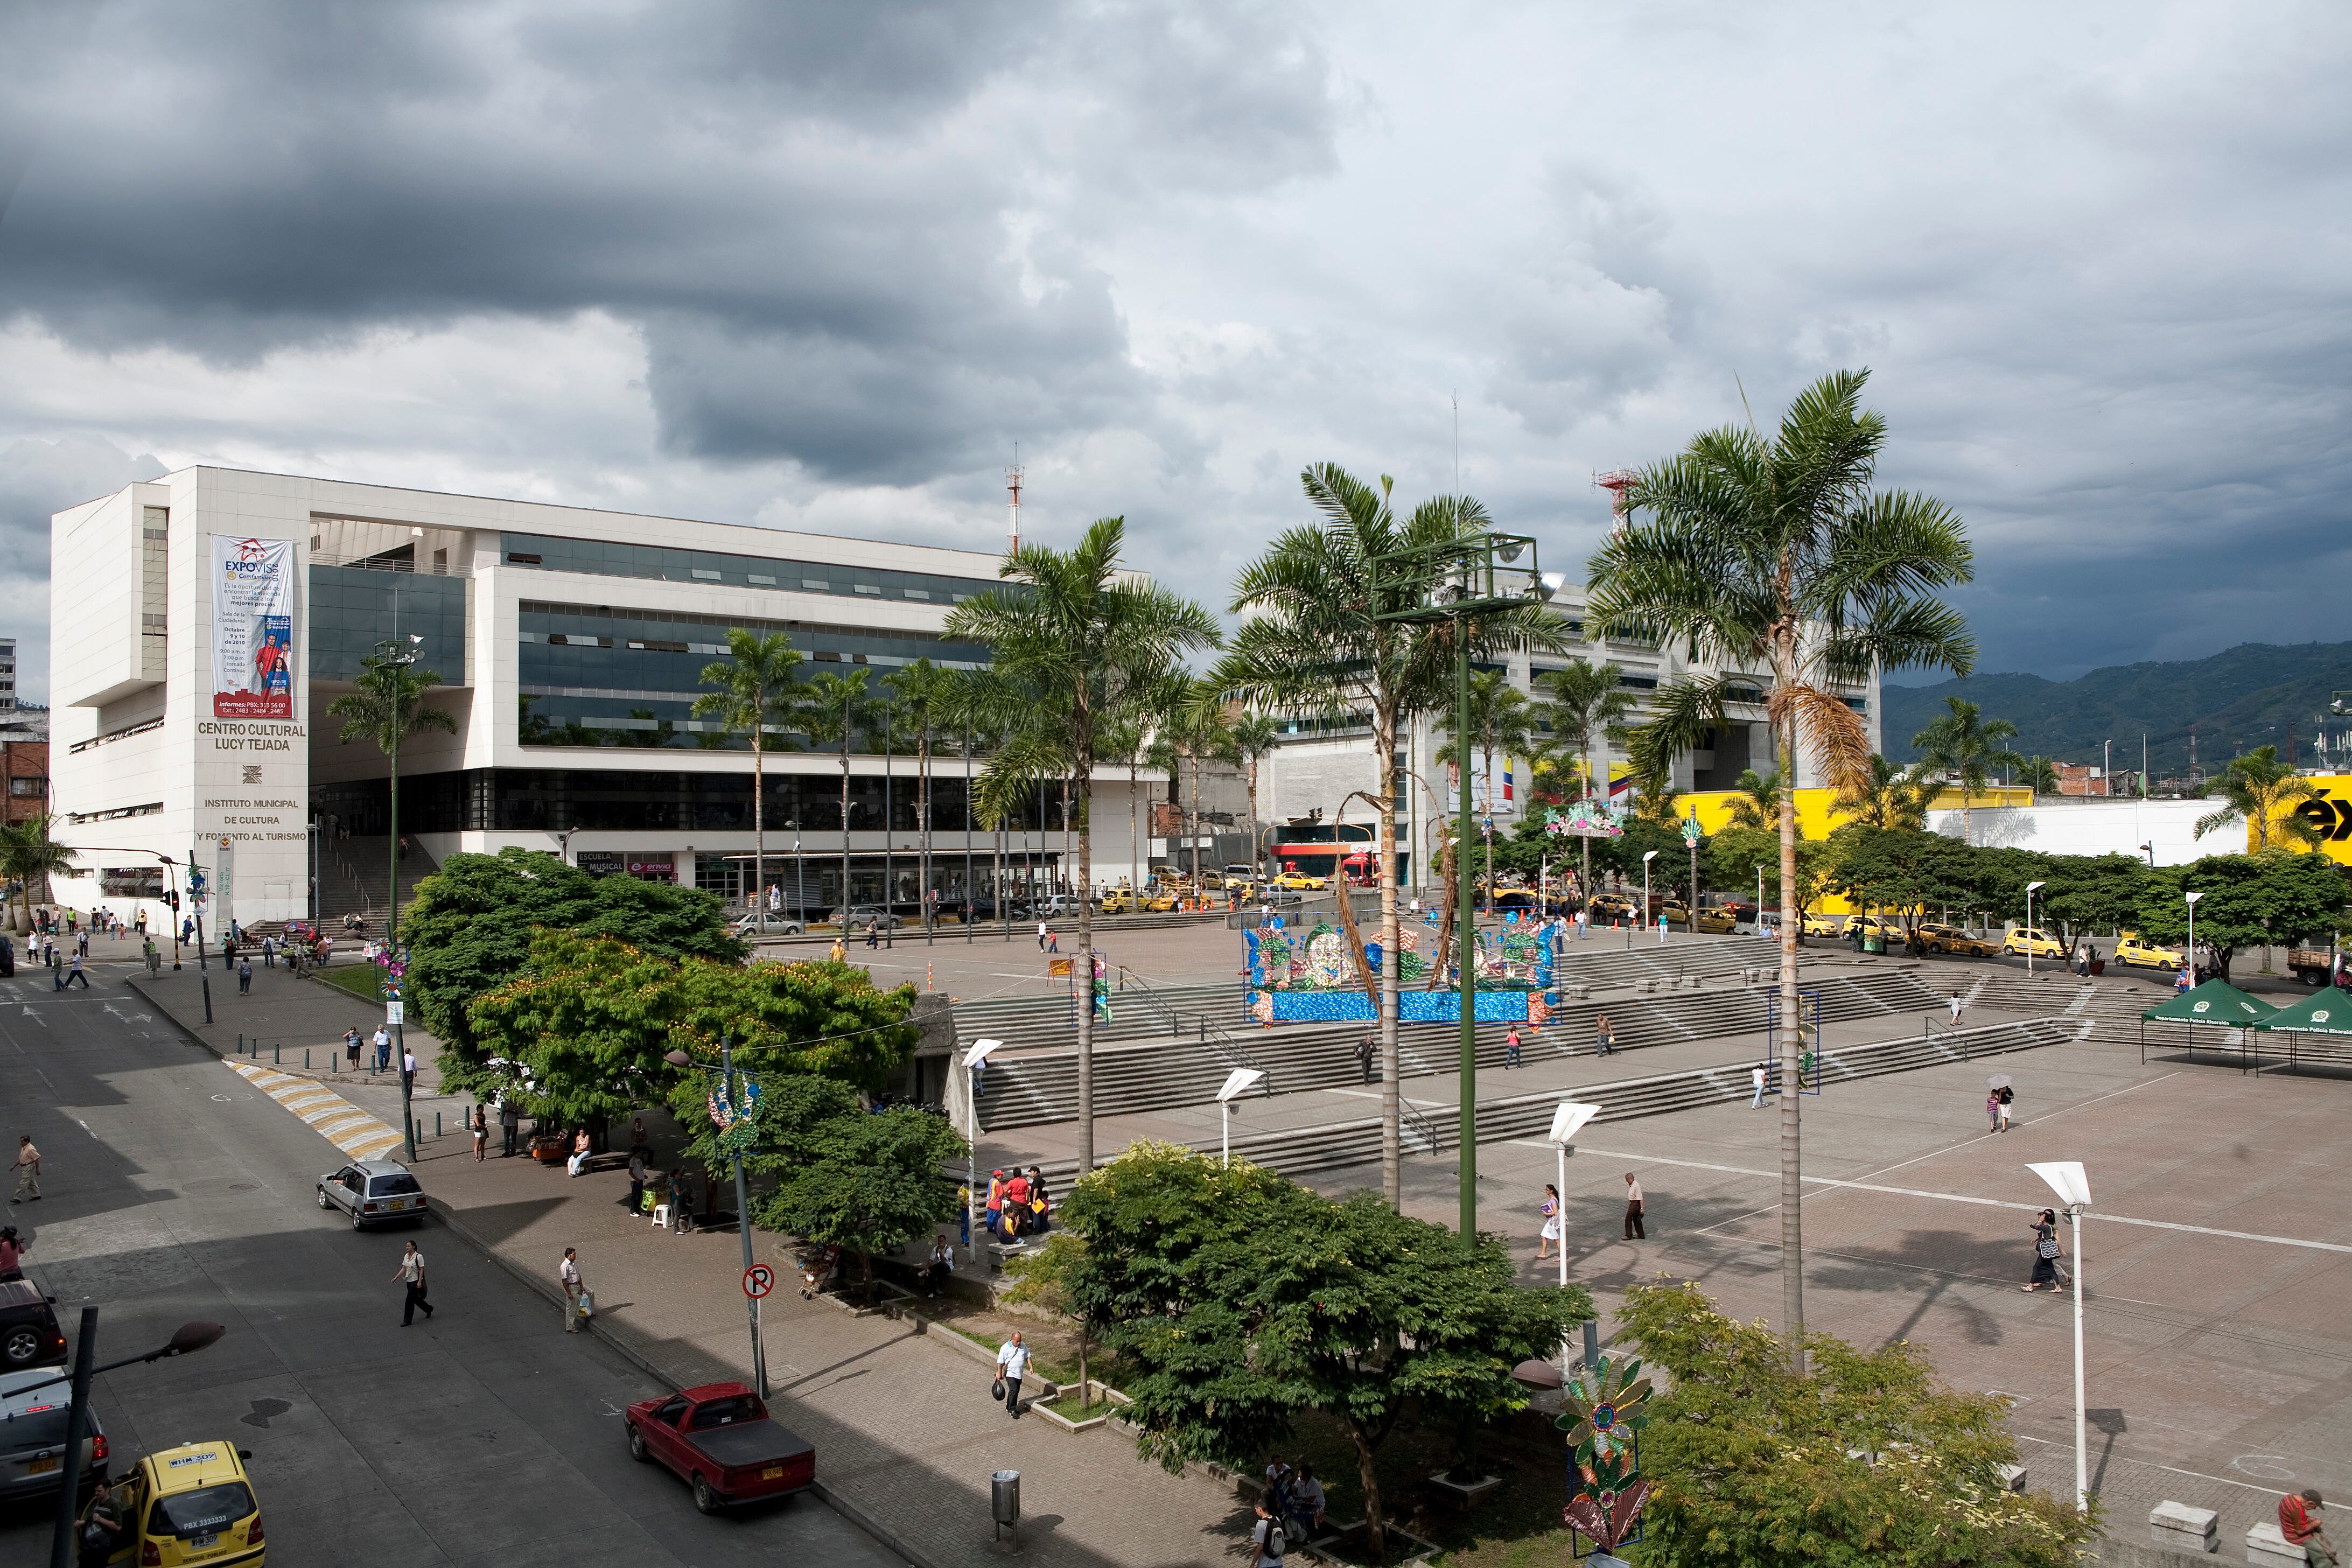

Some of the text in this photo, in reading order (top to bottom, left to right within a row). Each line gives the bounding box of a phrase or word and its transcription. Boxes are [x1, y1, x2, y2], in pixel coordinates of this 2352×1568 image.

[226, 561, 272, 573] EXPOVIS
[198, 722, 306, 737] CENTRO CULTURAL
[215, 738, 290, 751] LUCY TEJADA
[254, 800, 298, 808] MUNICIPAL
[753, 1269, 768, 1293] P
[199, 1515, 227, 1527] 3333333
